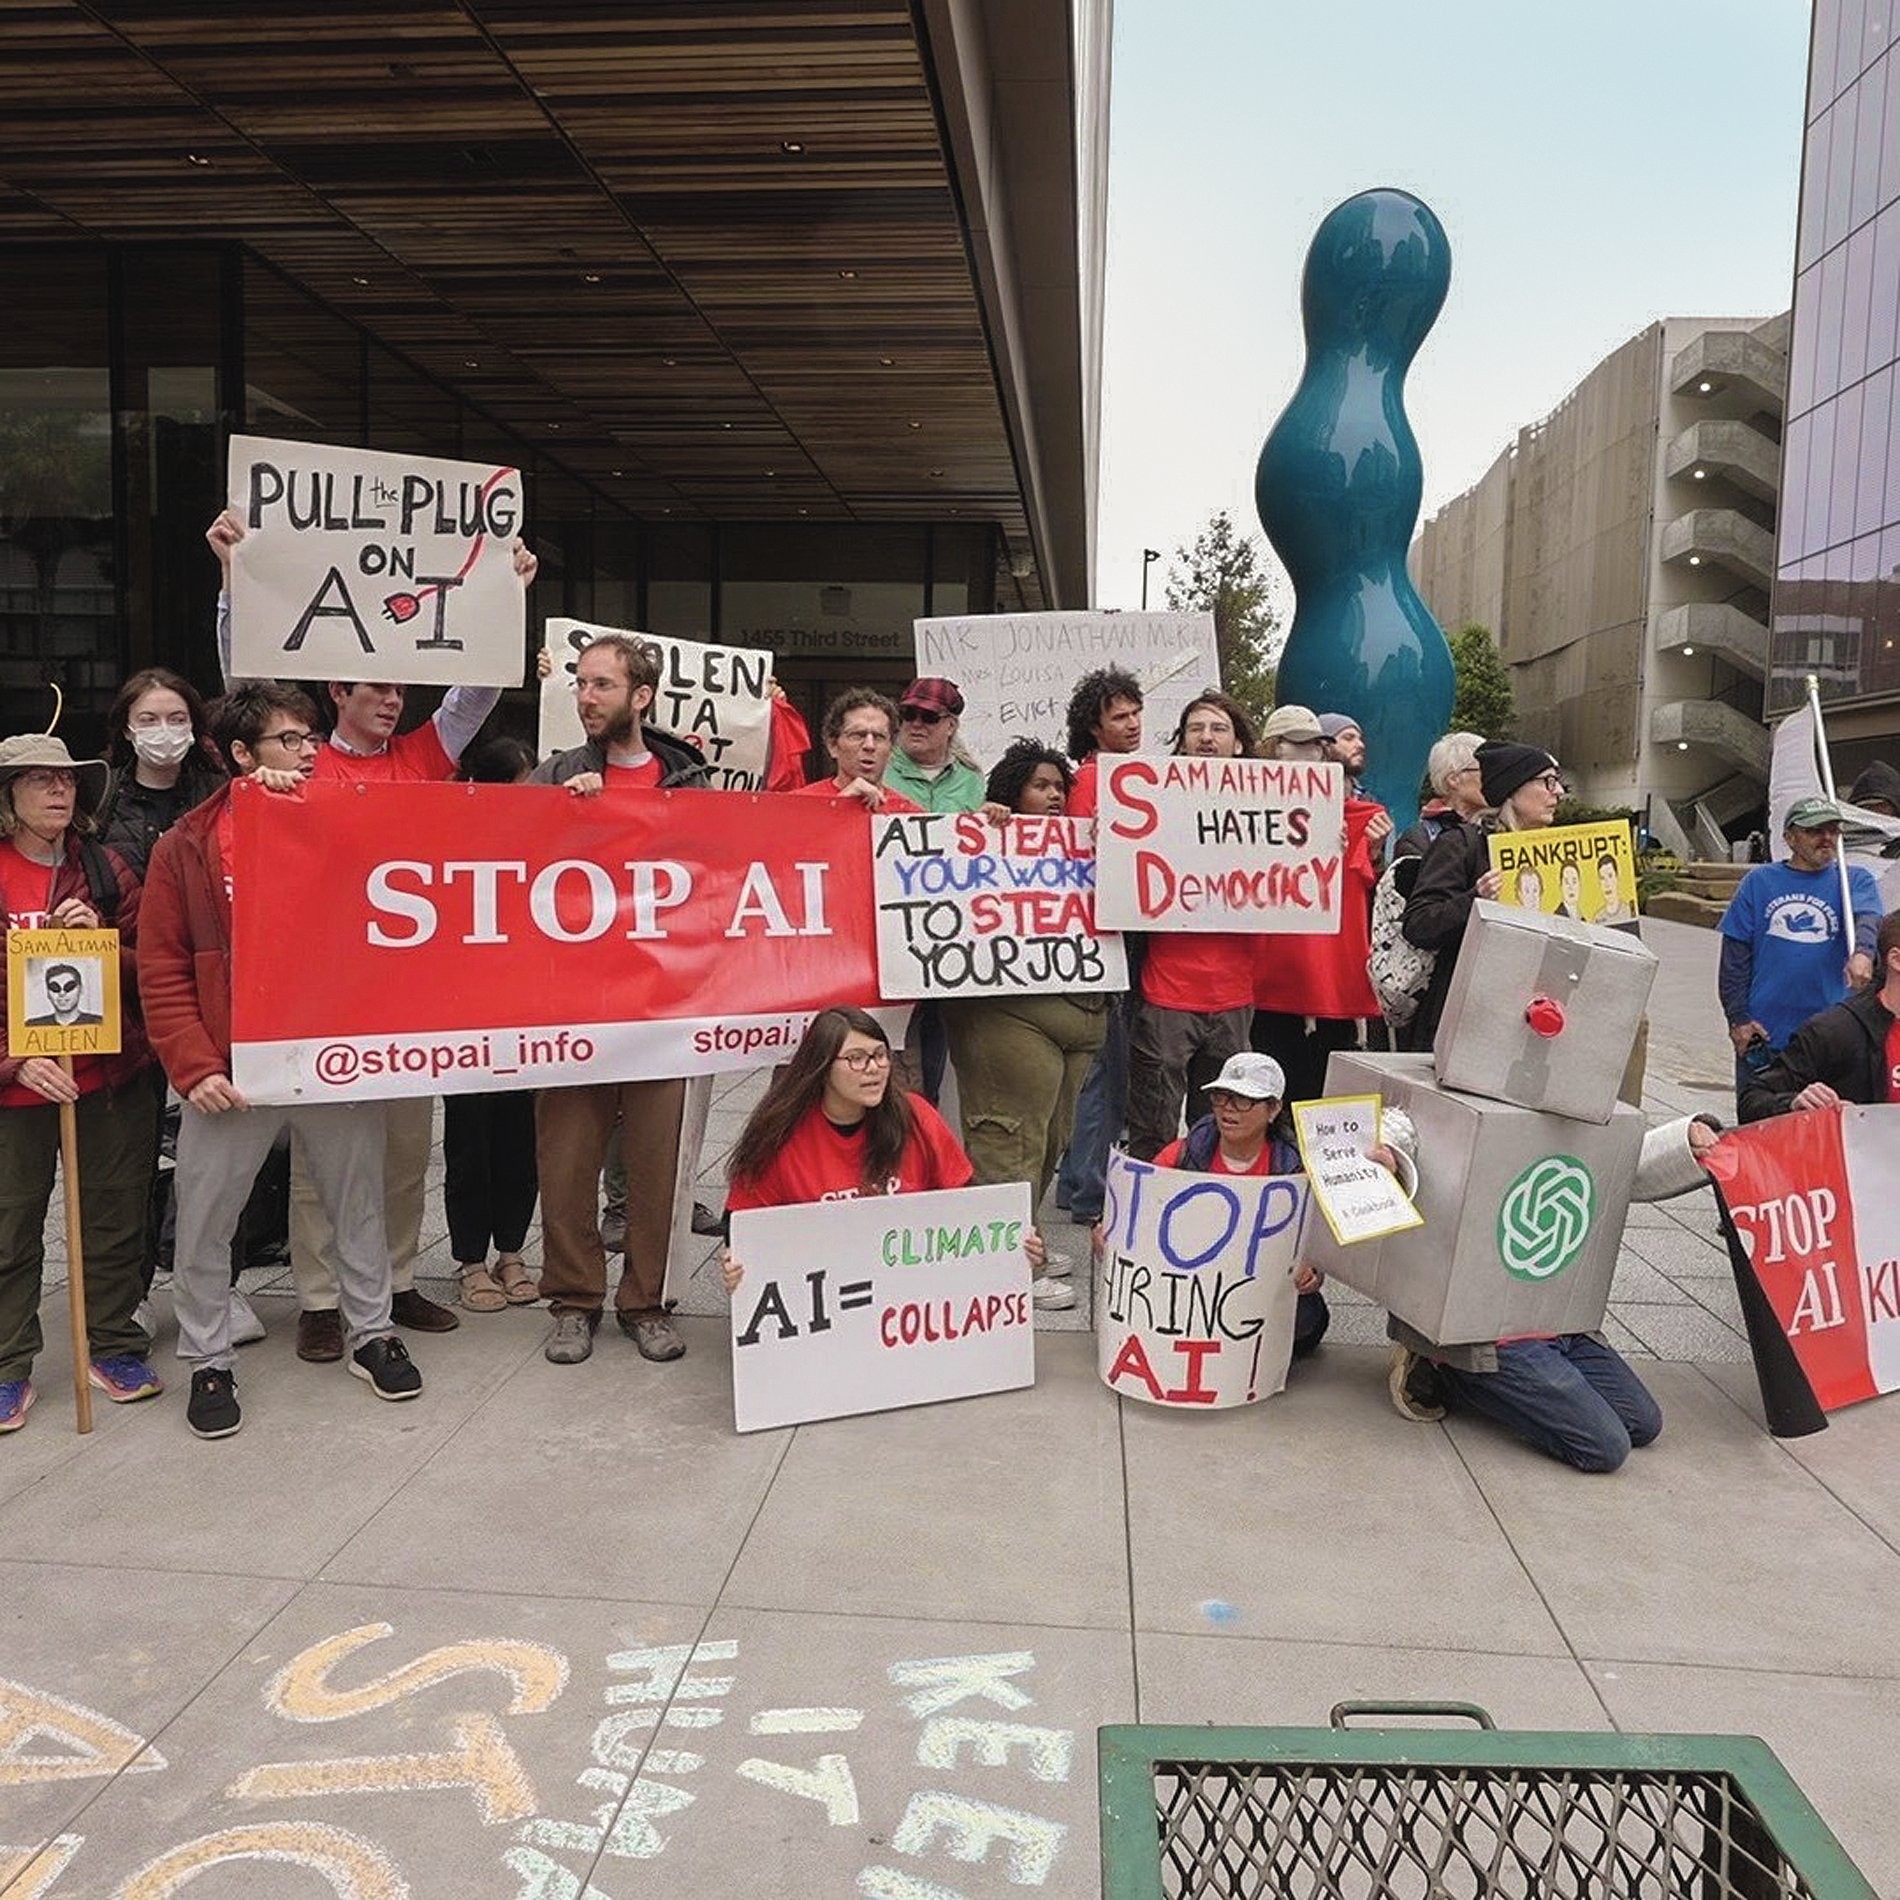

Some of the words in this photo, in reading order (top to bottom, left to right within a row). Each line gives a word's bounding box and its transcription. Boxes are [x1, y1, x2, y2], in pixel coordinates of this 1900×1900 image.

[248, 462, 385, 531] PULL
[371, 476, 399, 507] the
[400, 475, 516, 538] PLUG
[359, 544, 414, 579] ON
[742, 628, 785, 646] 1455
[789, 628, 837, 647] Third
[841, 629, 900, 648] Street
[1002, 622, 1134, 659] JONATHAN
[1109, 761, 1210, 840] SAM
[876, 815, 944, 859] AI
[955, 814, 1096, 861] STEAL
[1197, 807, 1311, 848] HATES
[894, 855, 999, 895] YOUR
[1002, 858, 1096, 888] WORK
[1500, 835, 1627, 870] BANKRUPT:
[365, 859, 693, 948] STOP
[724, 861, 833, 938] AI
[880, 900, 962, 942] TO
[970, 890, 1112, 939] STEA
[9, 932, 50, 954] SAM
[56, 931, 117, 951] ALTMAN
[907, 935, 1027, 988] YOUR
[1024, 933, 1105, 983] JOB
[26, 1027, 99, 1051] ALIEN
[315, 1031, 595, 1085] @stopai_info
[693, 1018, 809, 1055] stopai.i
[1343, 1122, 1359, 1133] to
[1323, 1147, 1356, 1161] Serve
[882, 1221, 1022, 1267] CLIMATE
[1729, 1188, 1837, 1264] STOP
[880, 1292, 1028, 1348] COLLAPSE
[1787, 1261, 1846, 1338] AI
[736, 1707, 865, 1826] IT
[857, 1650, 1075, 1900] KEE
